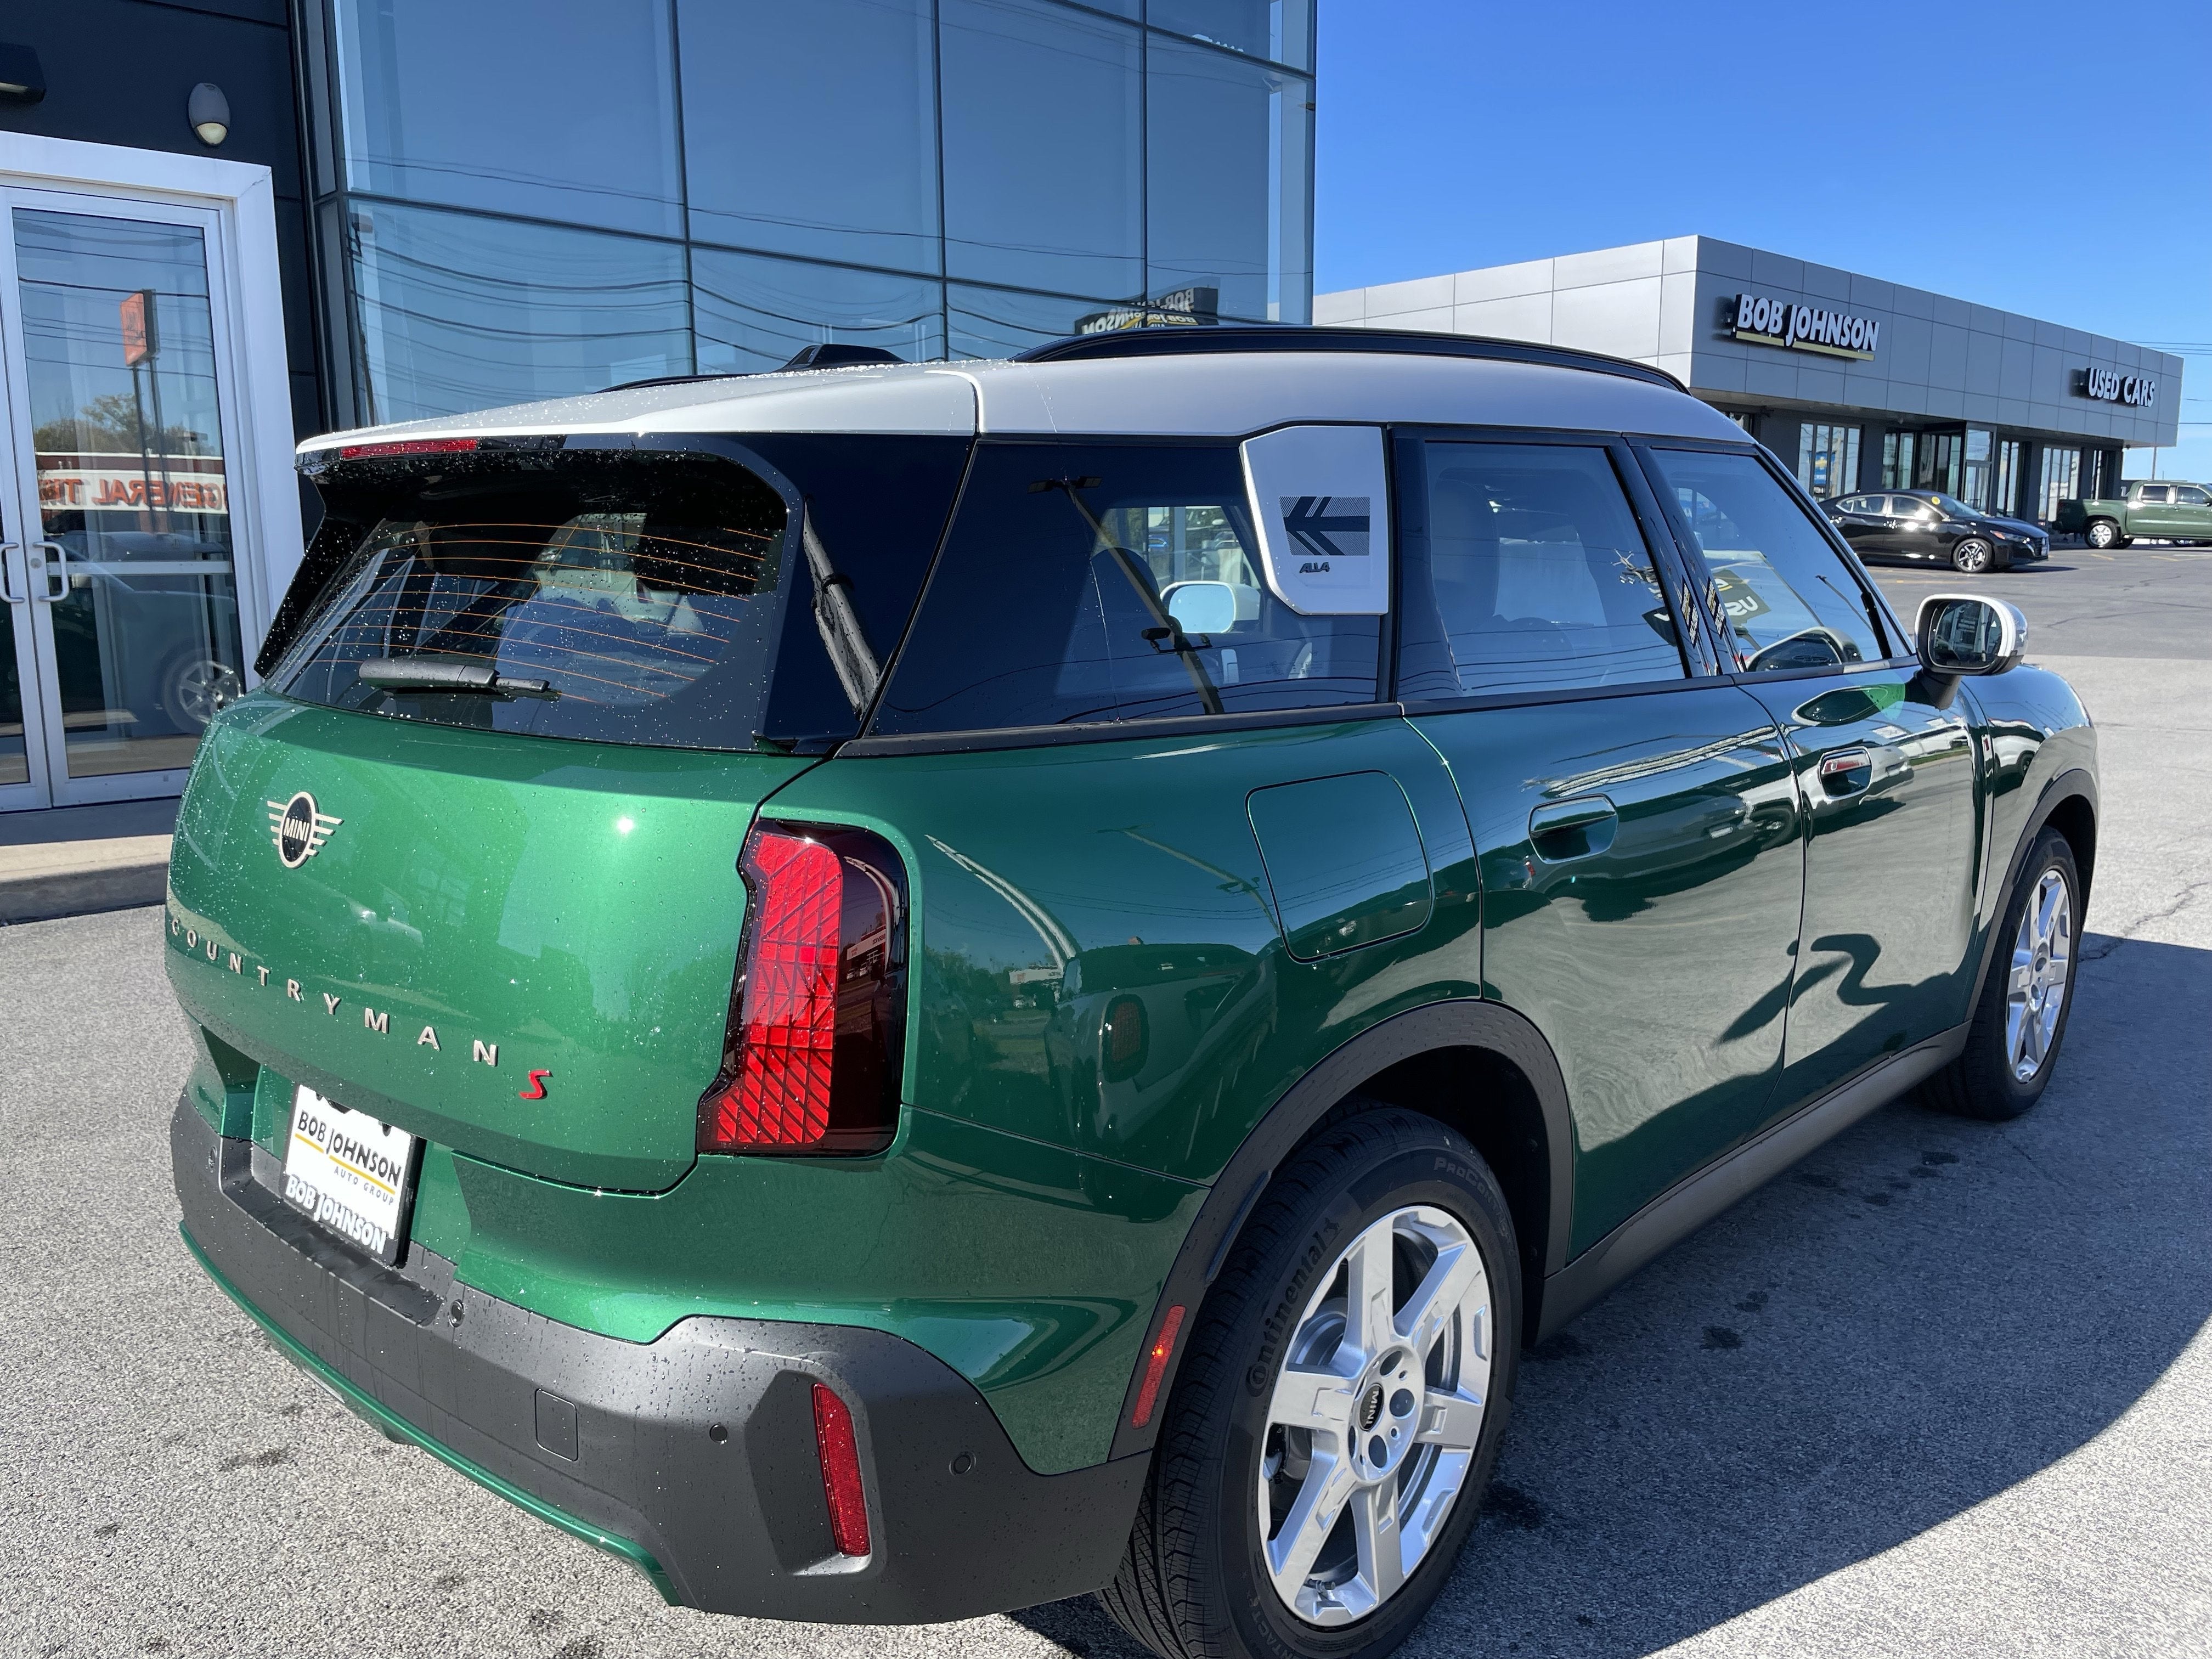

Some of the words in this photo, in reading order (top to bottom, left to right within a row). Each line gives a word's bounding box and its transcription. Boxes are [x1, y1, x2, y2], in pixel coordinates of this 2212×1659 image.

[1737, 294, 1784, 334] BOB
[1786, 304, 1880, 351] JOHNSON
[2089, 367, 2120, 400] USED
[2124, 376, 2155, 407] CARS
[283, 817, 310, 842] MINI
[172, 917, 499, 1067] COUNTRYMAN
[519, 1070, 553, 1099] S
[297, 1110, 327, 1143] BOB
[326, 1128, 402, 1187] JOHNSON
[285, 1174, 317, 1209] BOB
[313, 1193, 389, 1255] JOHNSON
[334, 1166, 358, 1185] AUTO
[364, 1182, 394, 1206] GROUP
[1245, 1231, 1327, 1397] Continental
[1365, 1391, 1379, 1424] MINI
